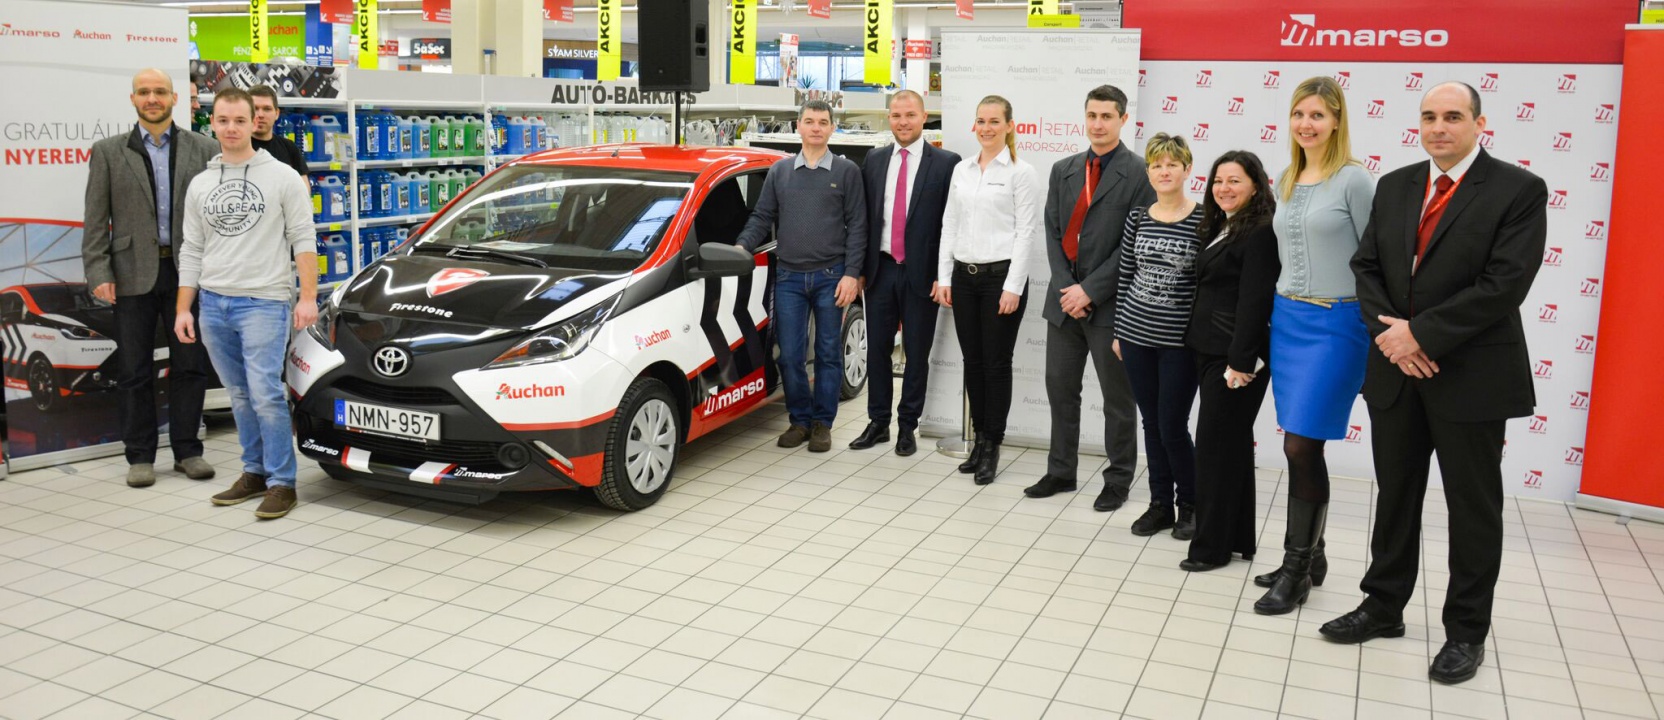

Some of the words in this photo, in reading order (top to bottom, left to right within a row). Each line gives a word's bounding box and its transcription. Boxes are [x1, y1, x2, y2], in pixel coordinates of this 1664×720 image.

[73, 29, 112, 40] Auchan
[733, 0, 745, 54] AKCI
[126, 34, 178, 43] Firestone
[1316, 29, 1448, 47] marso
[1007, 65, 1038, 73] Auchan
[1075, 67, 1106, 75] Auchan
[5, 149, 92, 166] NYEREM
[218, 183, 236, 194] EVER
[389, 302, 454, 319] Firestone
[635, 327, 672, 351] Auchan
[495, 383, 565, 400] Auchan
[337, 414, 344, 422] H
[349, 404, 434, 436] NMN-957
